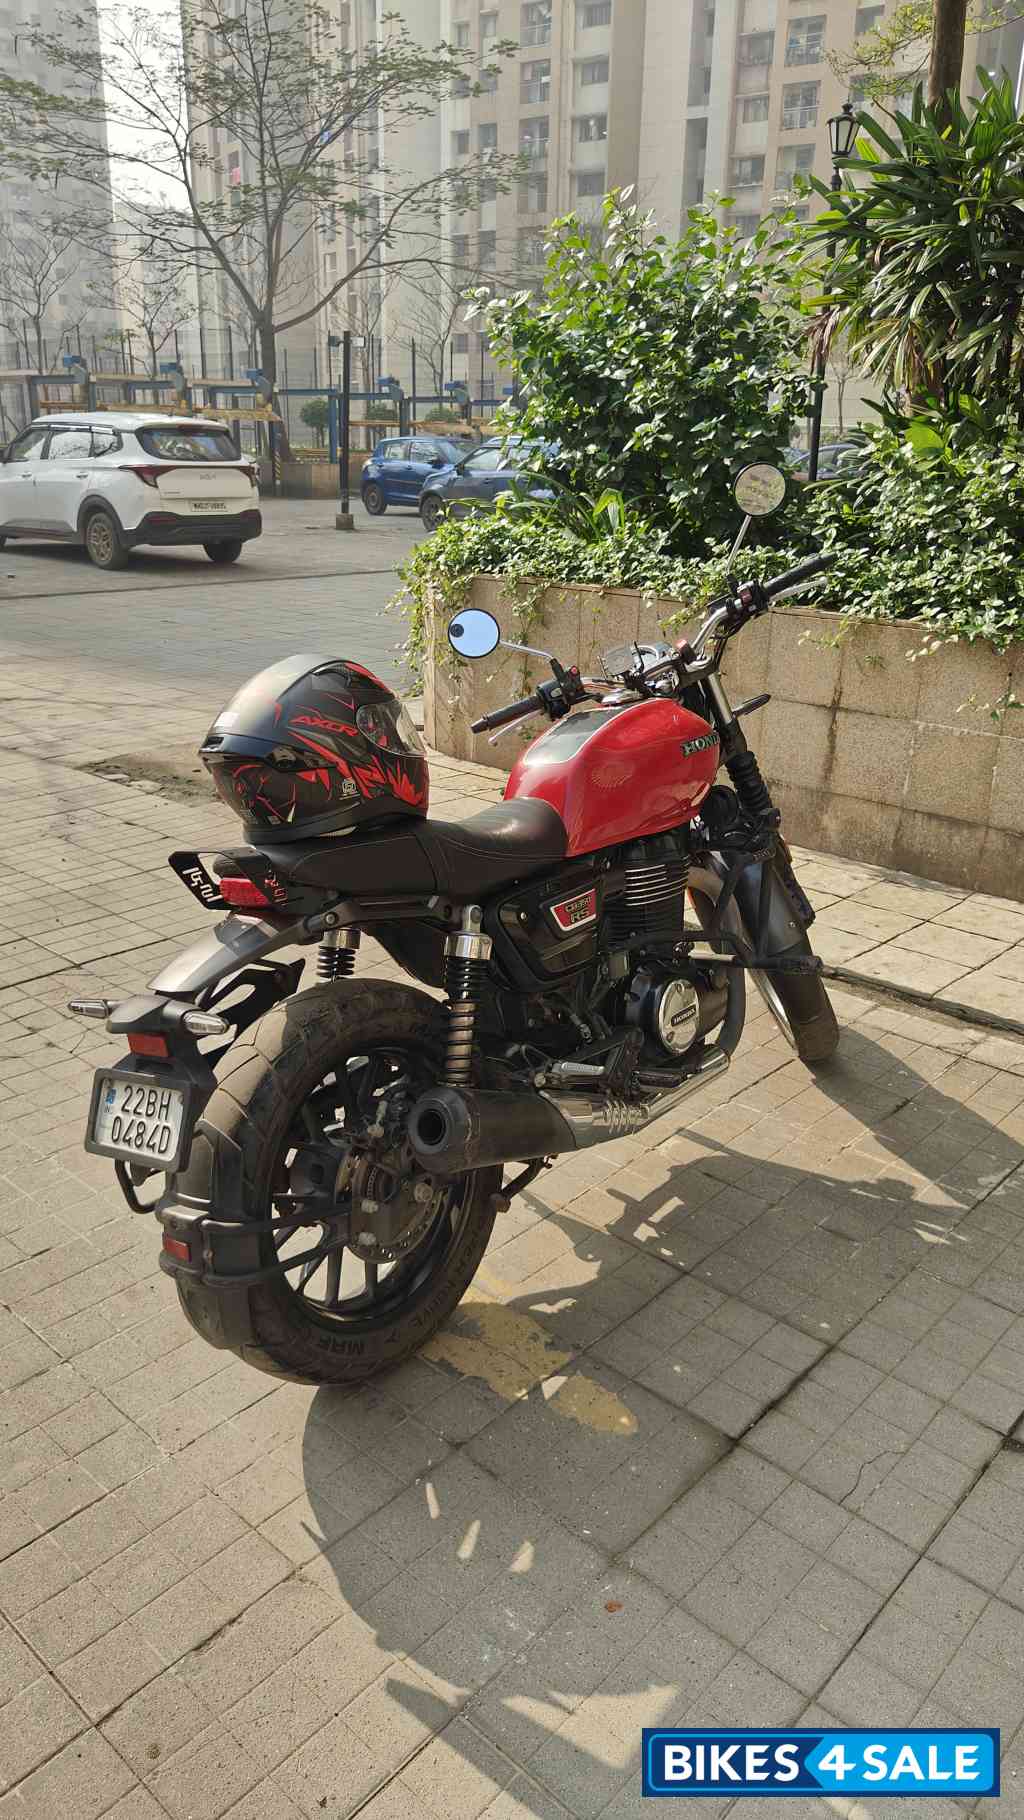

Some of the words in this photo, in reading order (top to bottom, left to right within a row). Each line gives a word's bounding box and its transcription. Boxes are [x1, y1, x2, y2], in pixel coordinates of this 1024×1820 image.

[288, 715, 358, 737] AXOR
[570, 906, 591, 923] RS
[673, 1008, 696, 1025] HONDA
[121, 1085, 171, 1121] 22BH
[111, 1116, 171, 1154] 0484D
